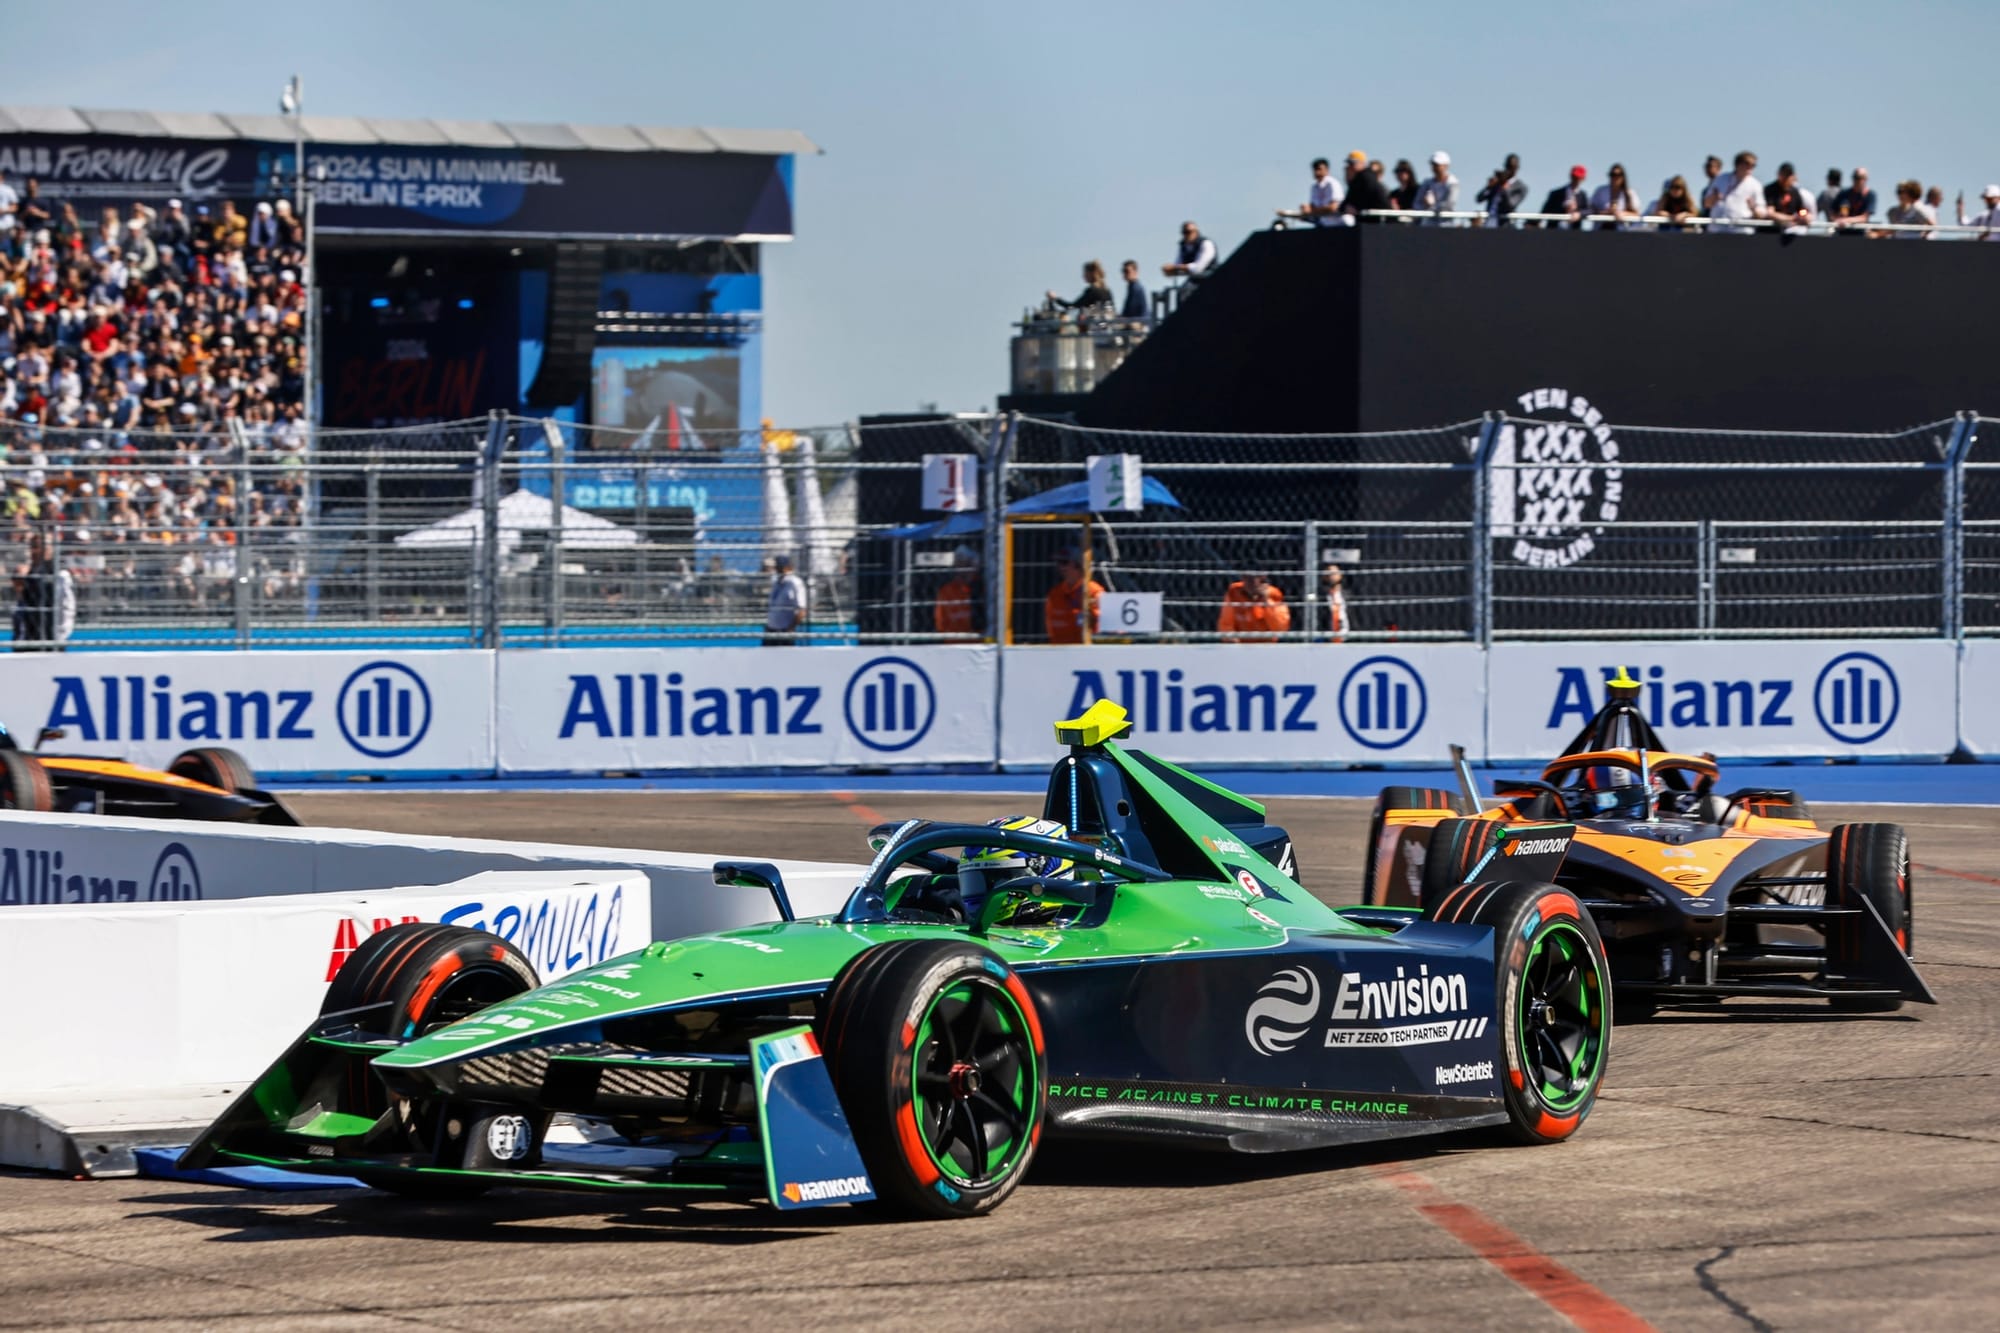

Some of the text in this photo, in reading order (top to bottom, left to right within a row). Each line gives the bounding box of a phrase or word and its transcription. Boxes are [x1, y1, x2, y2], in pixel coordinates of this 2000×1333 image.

[52, 145, 187, 180] FORMULA
[308, 155, 563, 185] 2024 SUN MINIMEAL
[308, 182, 483, 207] BERLIN E-PRIX
[1517, 387, 1569, 414] TEN
[1512, 537, 1595, 569] BERLIN
[1120, 598, 1140, 626] 6
[46, 674, 315, 741] Allianz
[558, 671, 822, 739] Allianz
[1065, 668, 1318, 734] Allianz
[1331, 963, 1468, 1020] Envision
[1330, 1025, 1448, 1044] NET ZERO TECH PARTNER
[1435, 1060, 1494, 1085] NewScientist
[1049, 1085, 1409, 1115] RACE AGAINST CLIMATE CHANGE
